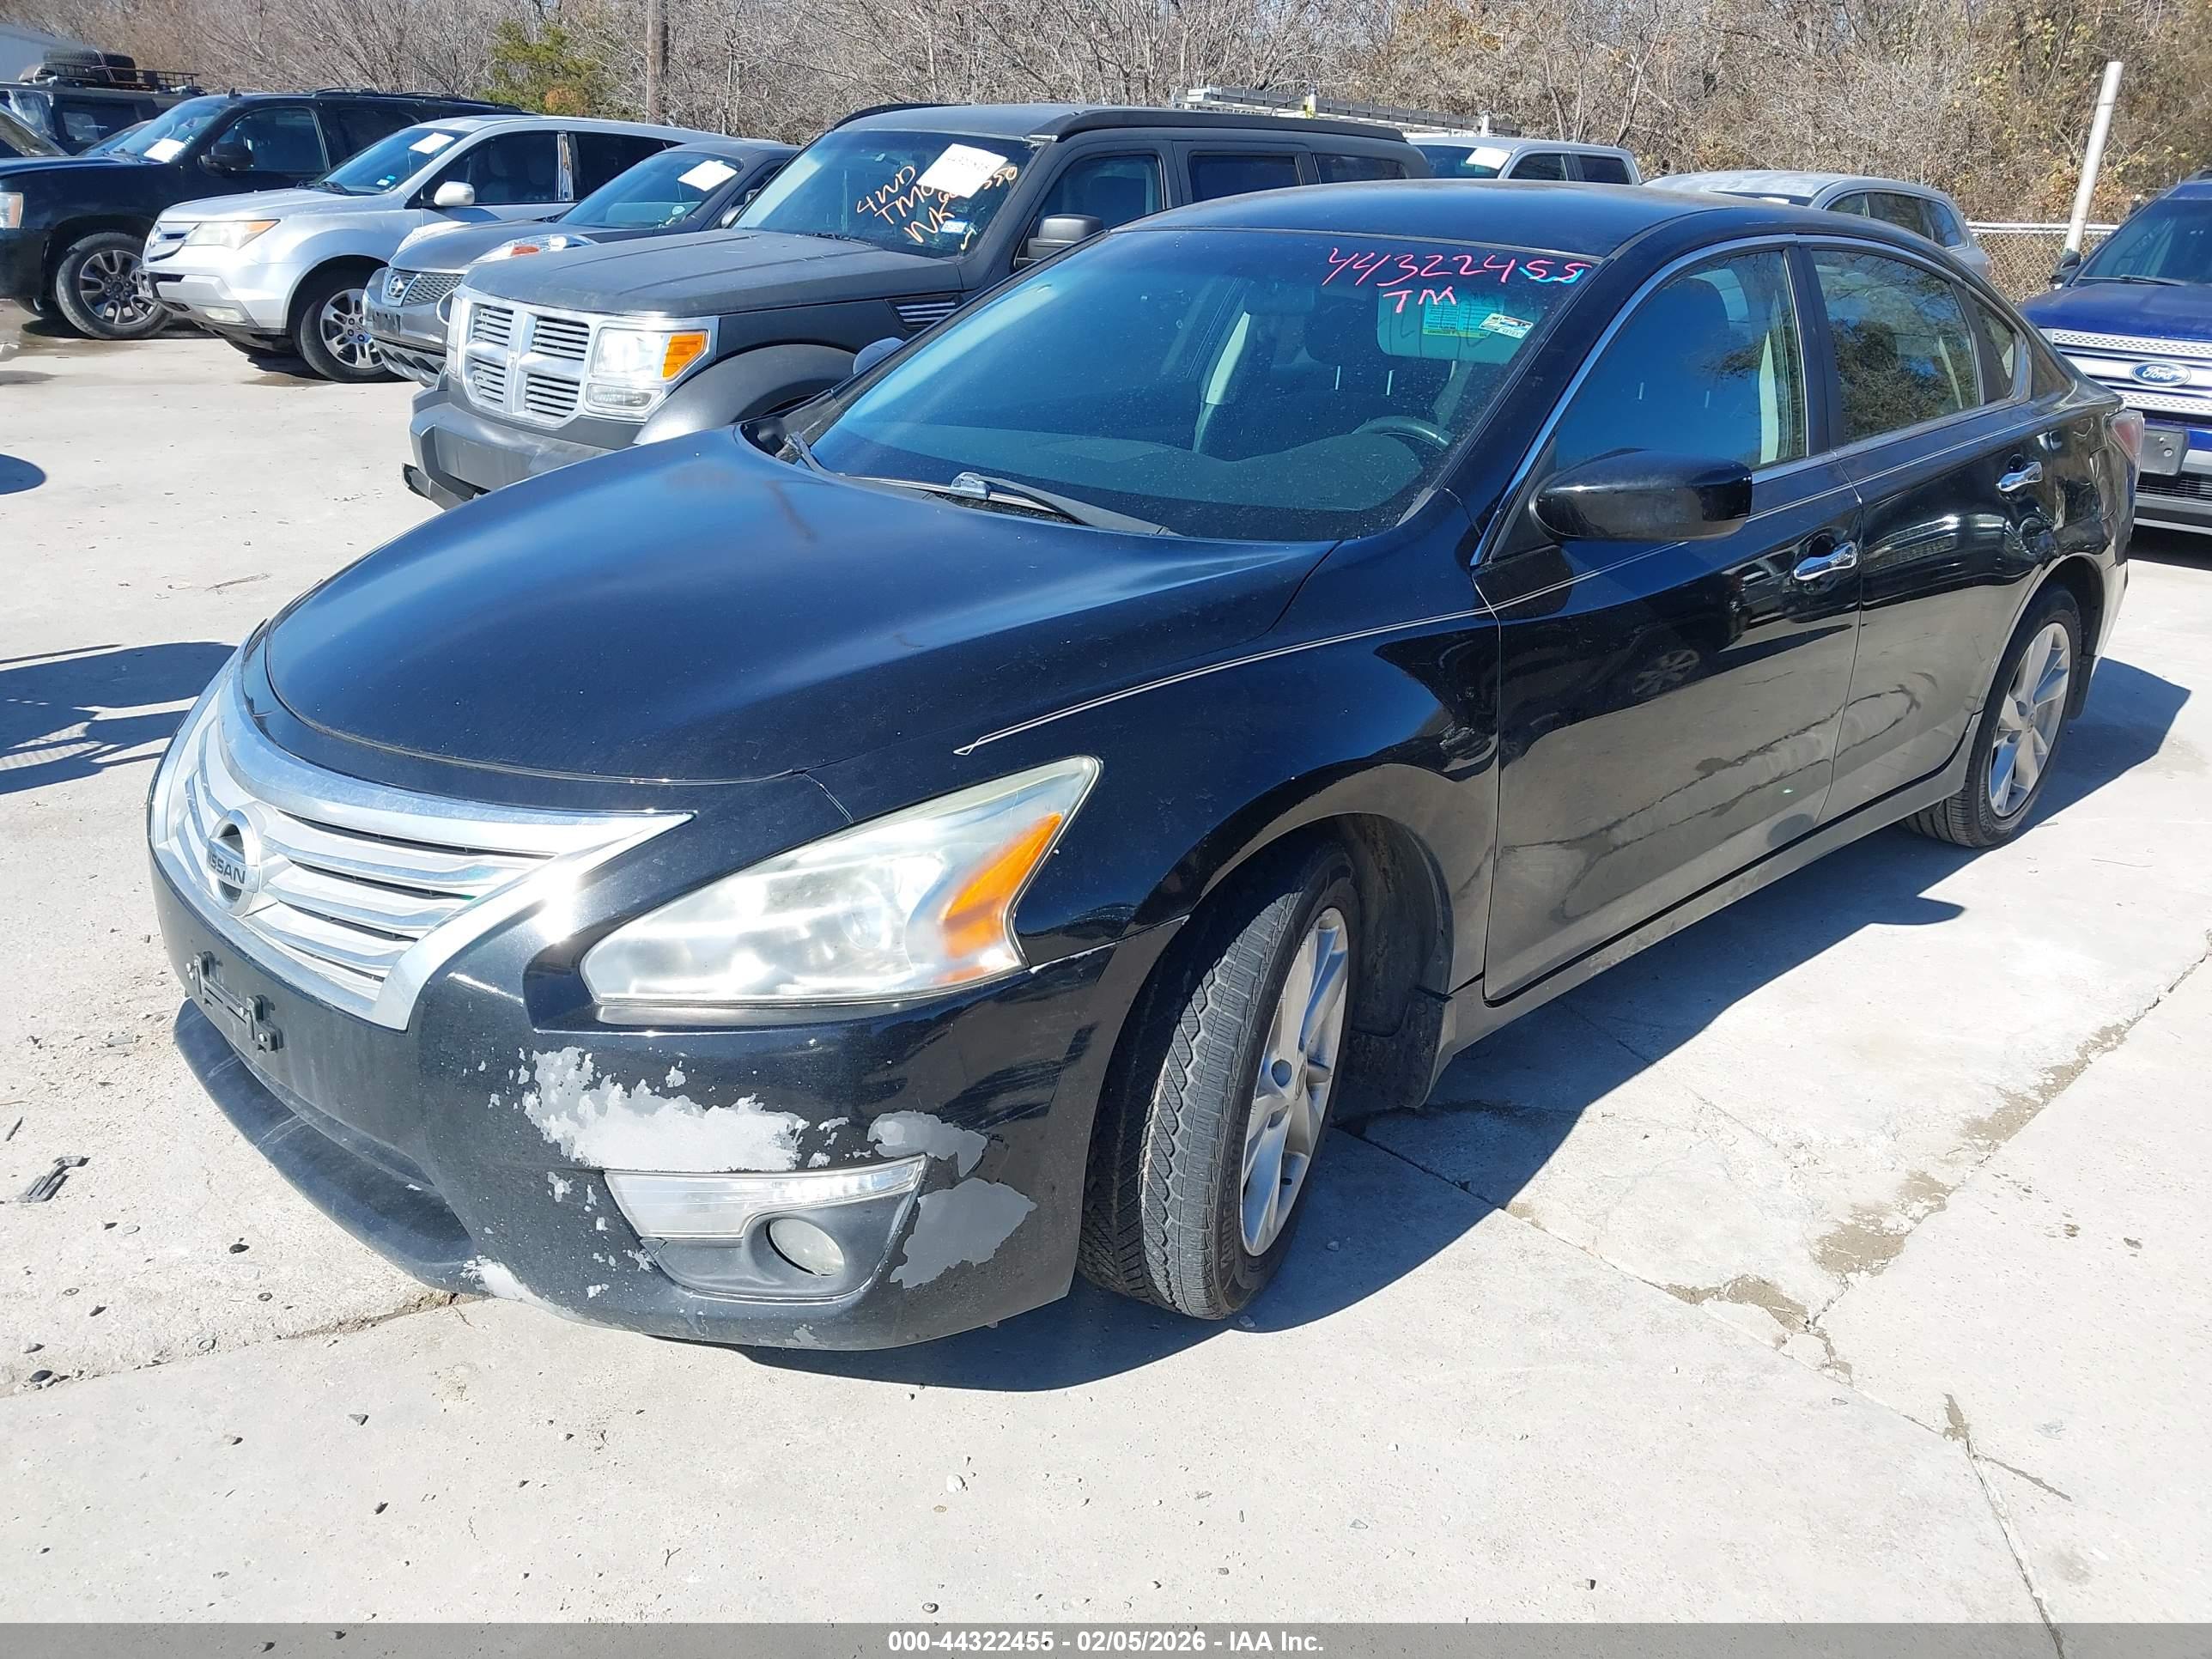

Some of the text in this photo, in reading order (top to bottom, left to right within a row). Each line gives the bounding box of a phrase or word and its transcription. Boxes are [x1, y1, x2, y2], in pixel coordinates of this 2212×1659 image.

[856, 166, 915, 213] 4WD
[1321, 246, 1594, 287] 44322455
[1382, 285, 1457, 313] TM
[2142, 365, 2183, 381] Ford
